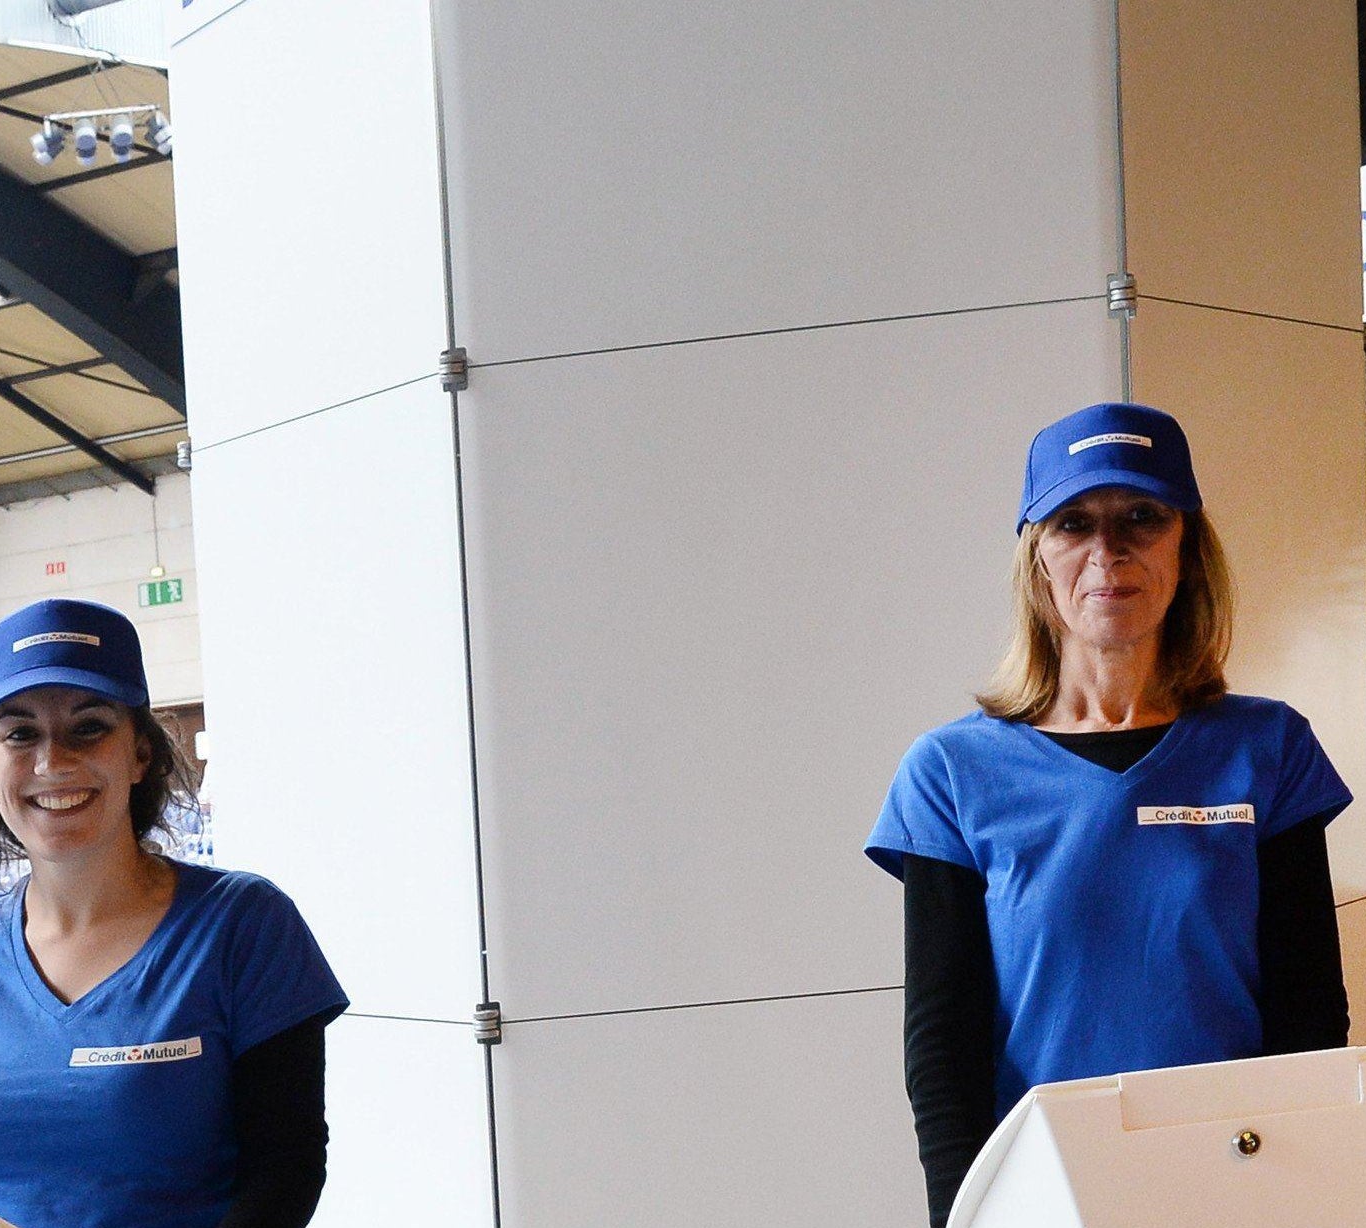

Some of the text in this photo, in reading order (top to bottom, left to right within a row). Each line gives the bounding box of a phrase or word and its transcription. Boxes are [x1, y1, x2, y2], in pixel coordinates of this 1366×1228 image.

[1155, 809, 1248, 821] Crédit Mutuel
[88, 1045, 187, 1063] Crédit Mutuel
